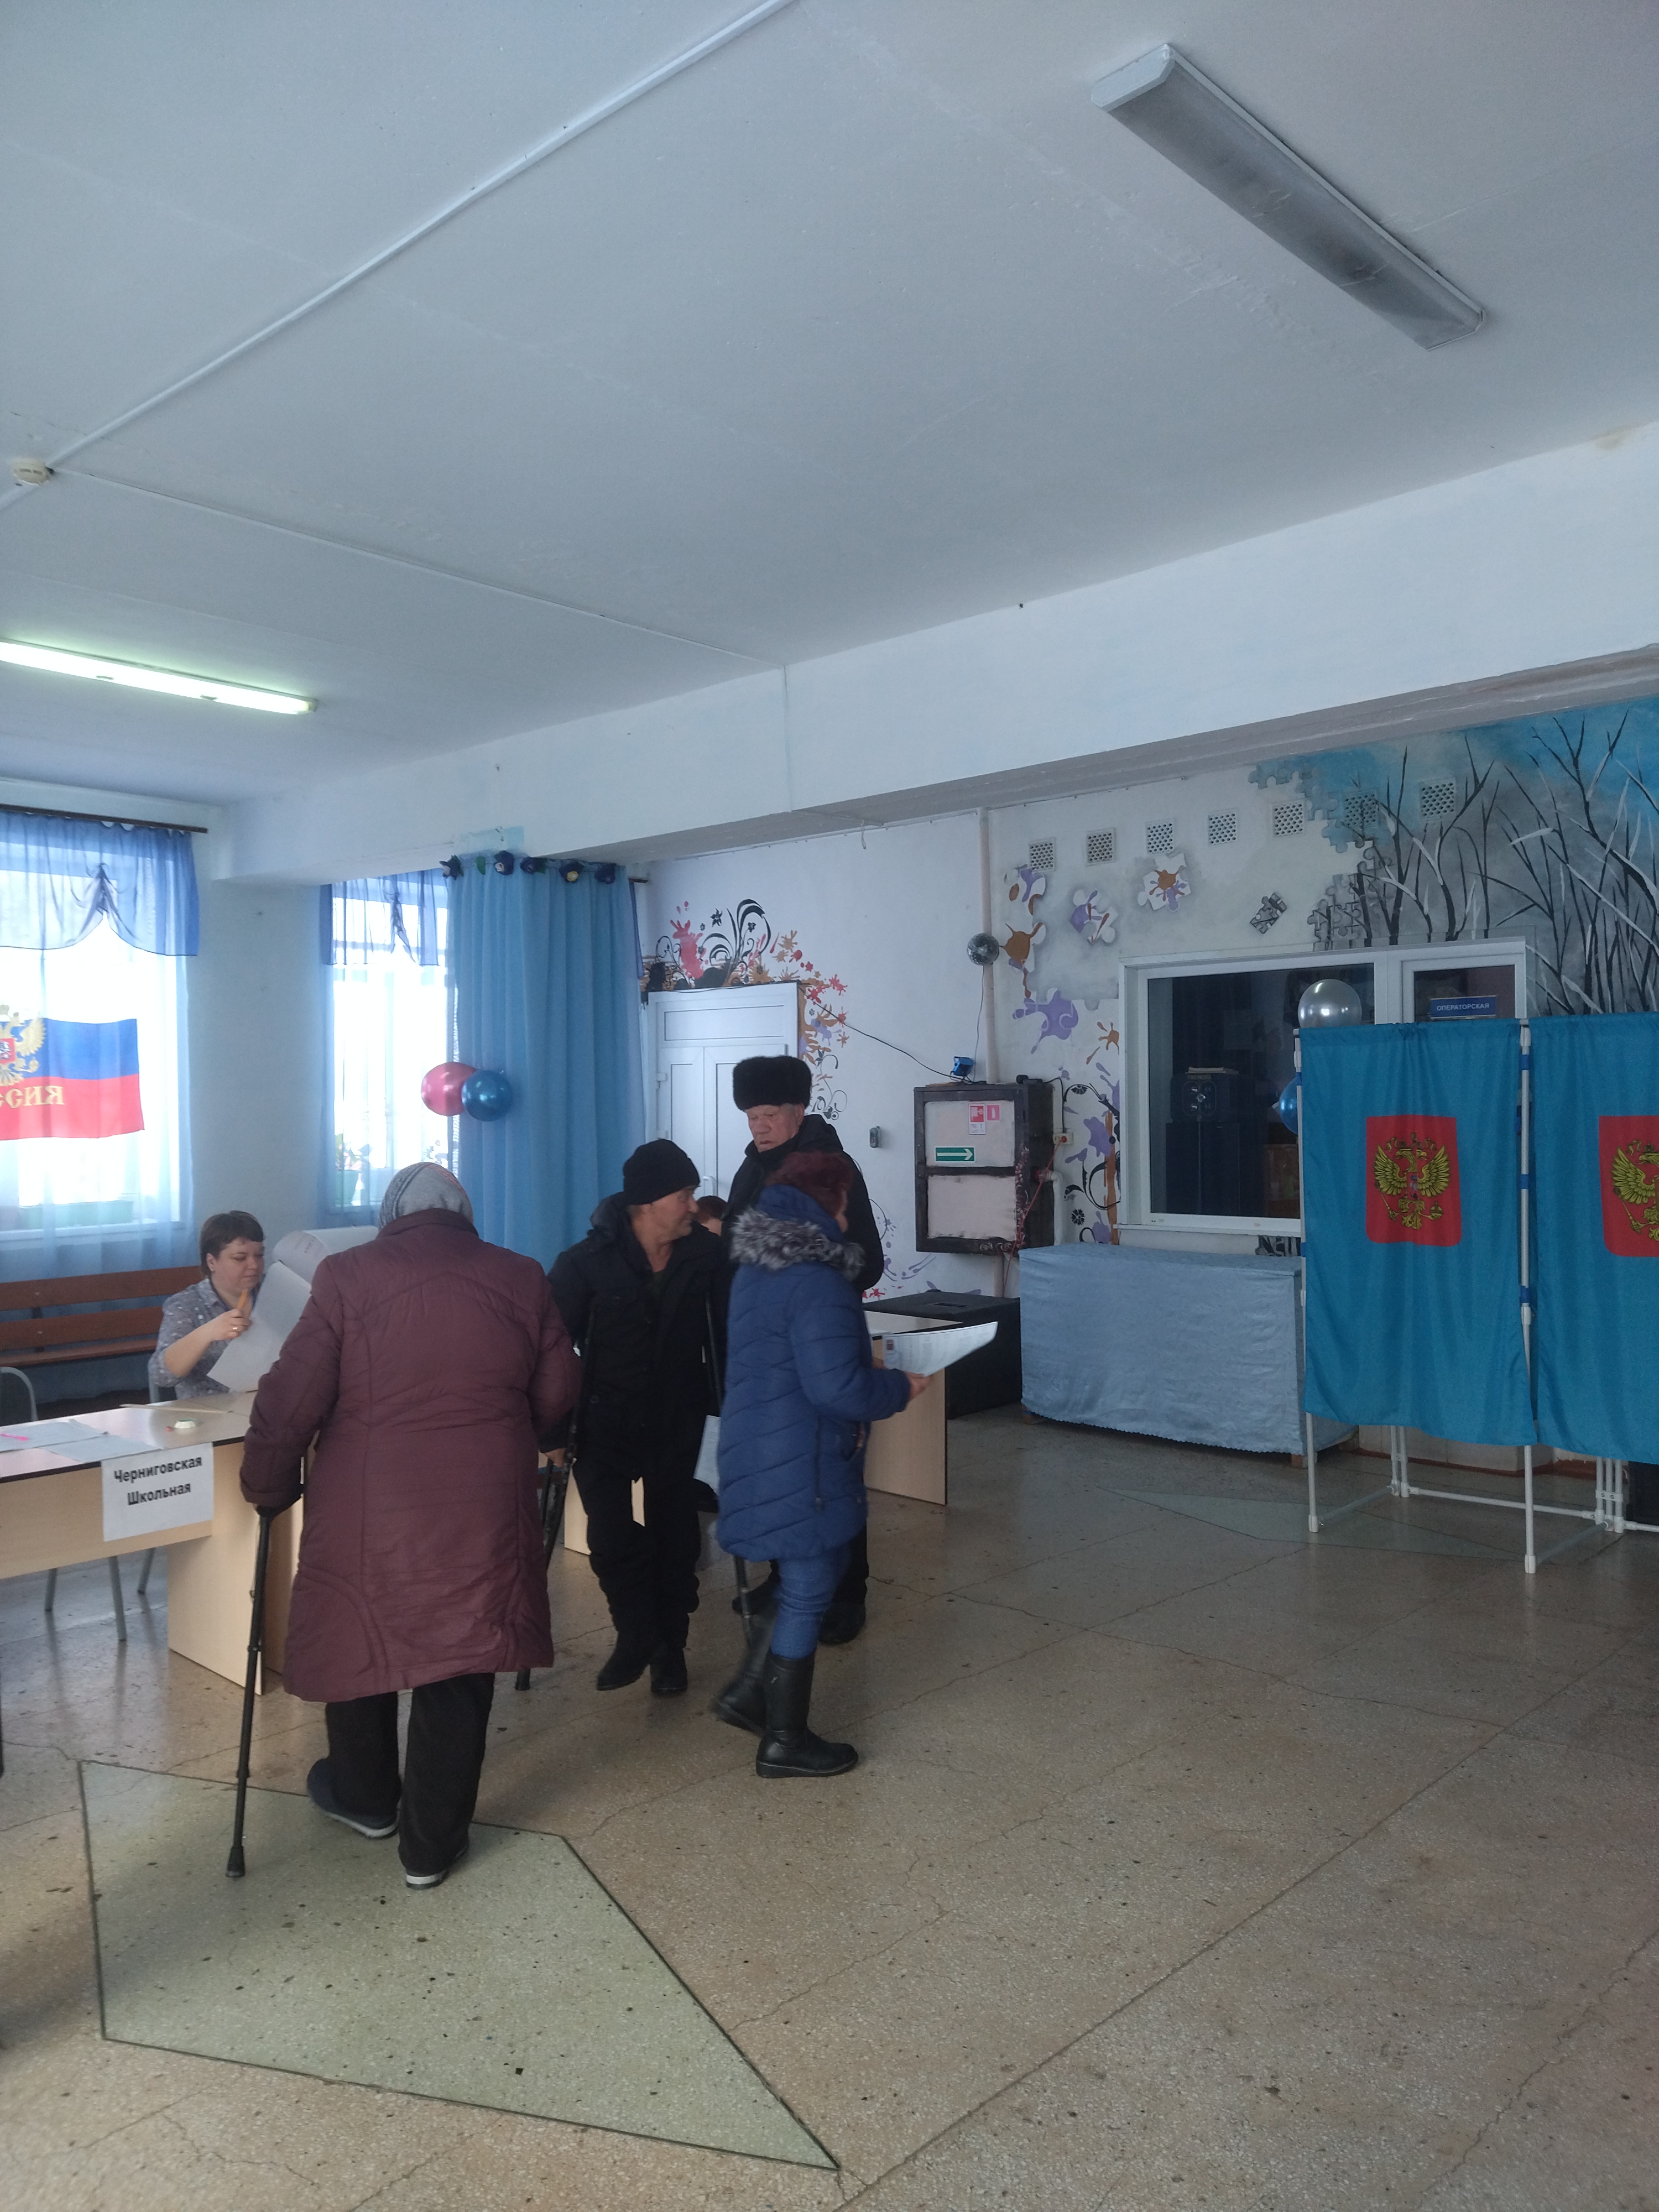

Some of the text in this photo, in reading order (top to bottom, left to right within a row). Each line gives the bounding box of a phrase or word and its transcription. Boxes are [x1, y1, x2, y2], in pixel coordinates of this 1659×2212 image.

[1436, 1003, 1490, 1011] ОПЕРАТОРСКАЯ
[0, 1085, 65, 1109] СИЯ
[114, 1457, 203, 1483] Черниговская
[127, 1483, 191, 1506] Школьная
